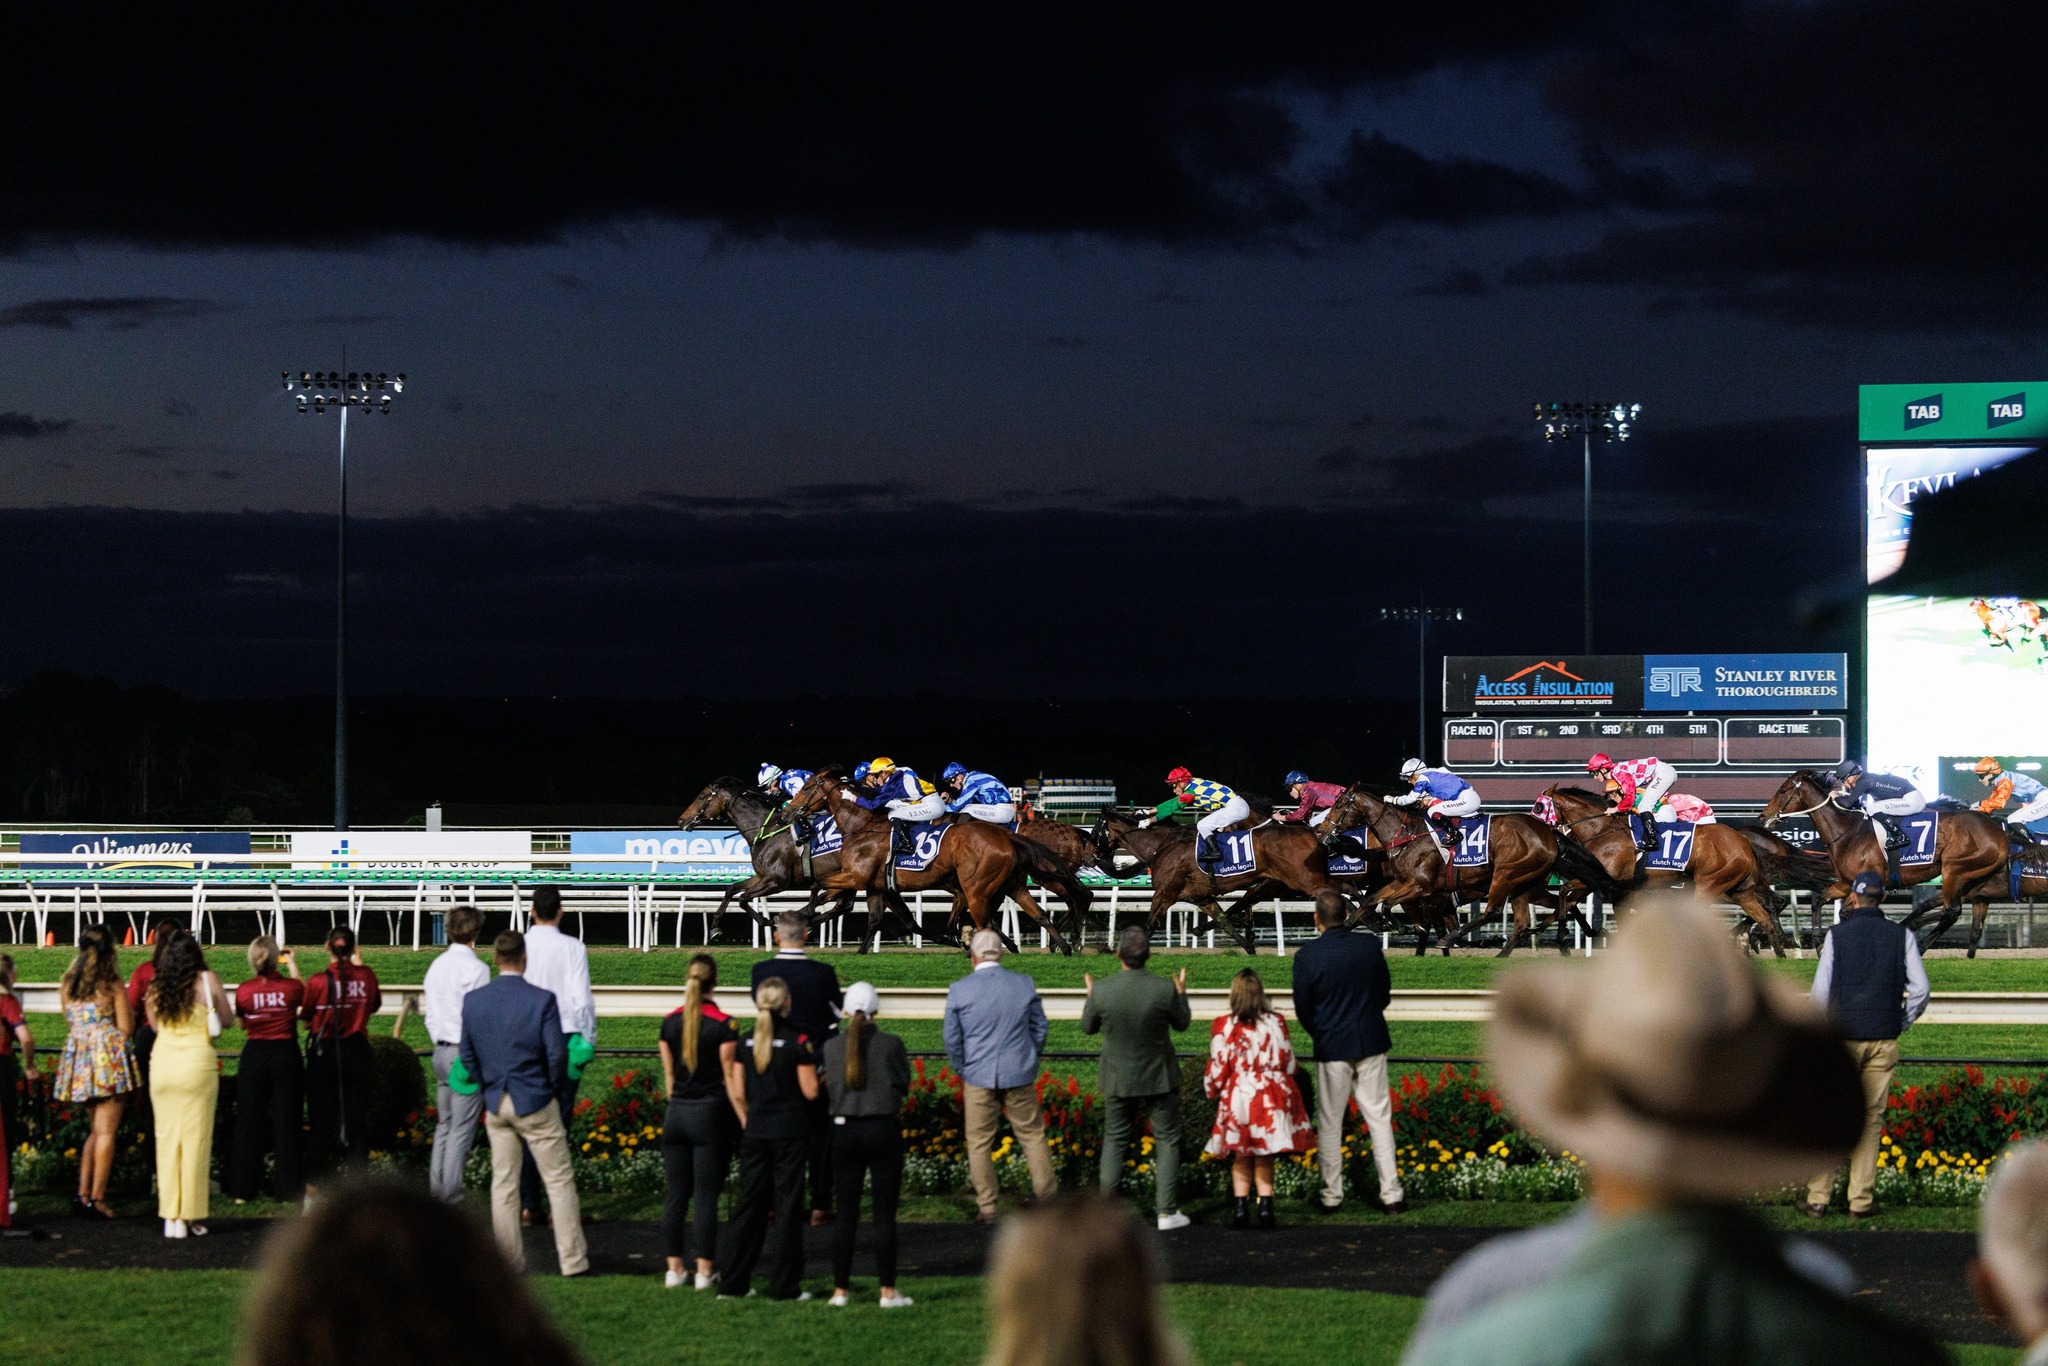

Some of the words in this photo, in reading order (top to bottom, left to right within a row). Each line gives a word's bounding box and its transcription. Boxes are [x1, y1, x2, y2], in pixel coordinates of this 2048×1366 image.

[1908, 405, 1940, 419] TAB
[1991, 404, 2023, 418] TAB
[1715, 666, 1785, 682] STANLEY
[1788, 670, 1837, 682] RIVER
[1475, 674, 1527, 696] ACCESS
[1532, 674, 1615, 696] INSULATION
[1649, 667, 1703, 697] STR
[1715, 685, 1838, 697] THOROUGHBREDS
[1475, 699, 1516, 707] INSULATION,
[1450, 725, 1477, 736] RACE
[1478, 725, 1493, 736] NO
[1517, 725, 1533, 735] 1ST
[1559, 725, 1579, 735] 2ND
[1601, 725, 1621, 735] 3RD
[1645, 724, 1664, 734] 4TH
[1688, 724, 1707, 734] 5TH
[1010, 789, 1020, 799] 14
[815, 814, 842, 844] 12
[1459, 824, 1486, 855] 14
[1911, 820, 1932, 853] 7
[915, 830, 941, 860] 15
[1226, 833, 1253, 864] 11
[1660, 829, 1692, 860] 17
[1219, 864, 1237, 873] clutch
[1329, 864, 1348, 872] clutch
[1651, 858, 1671, 866] clutch
